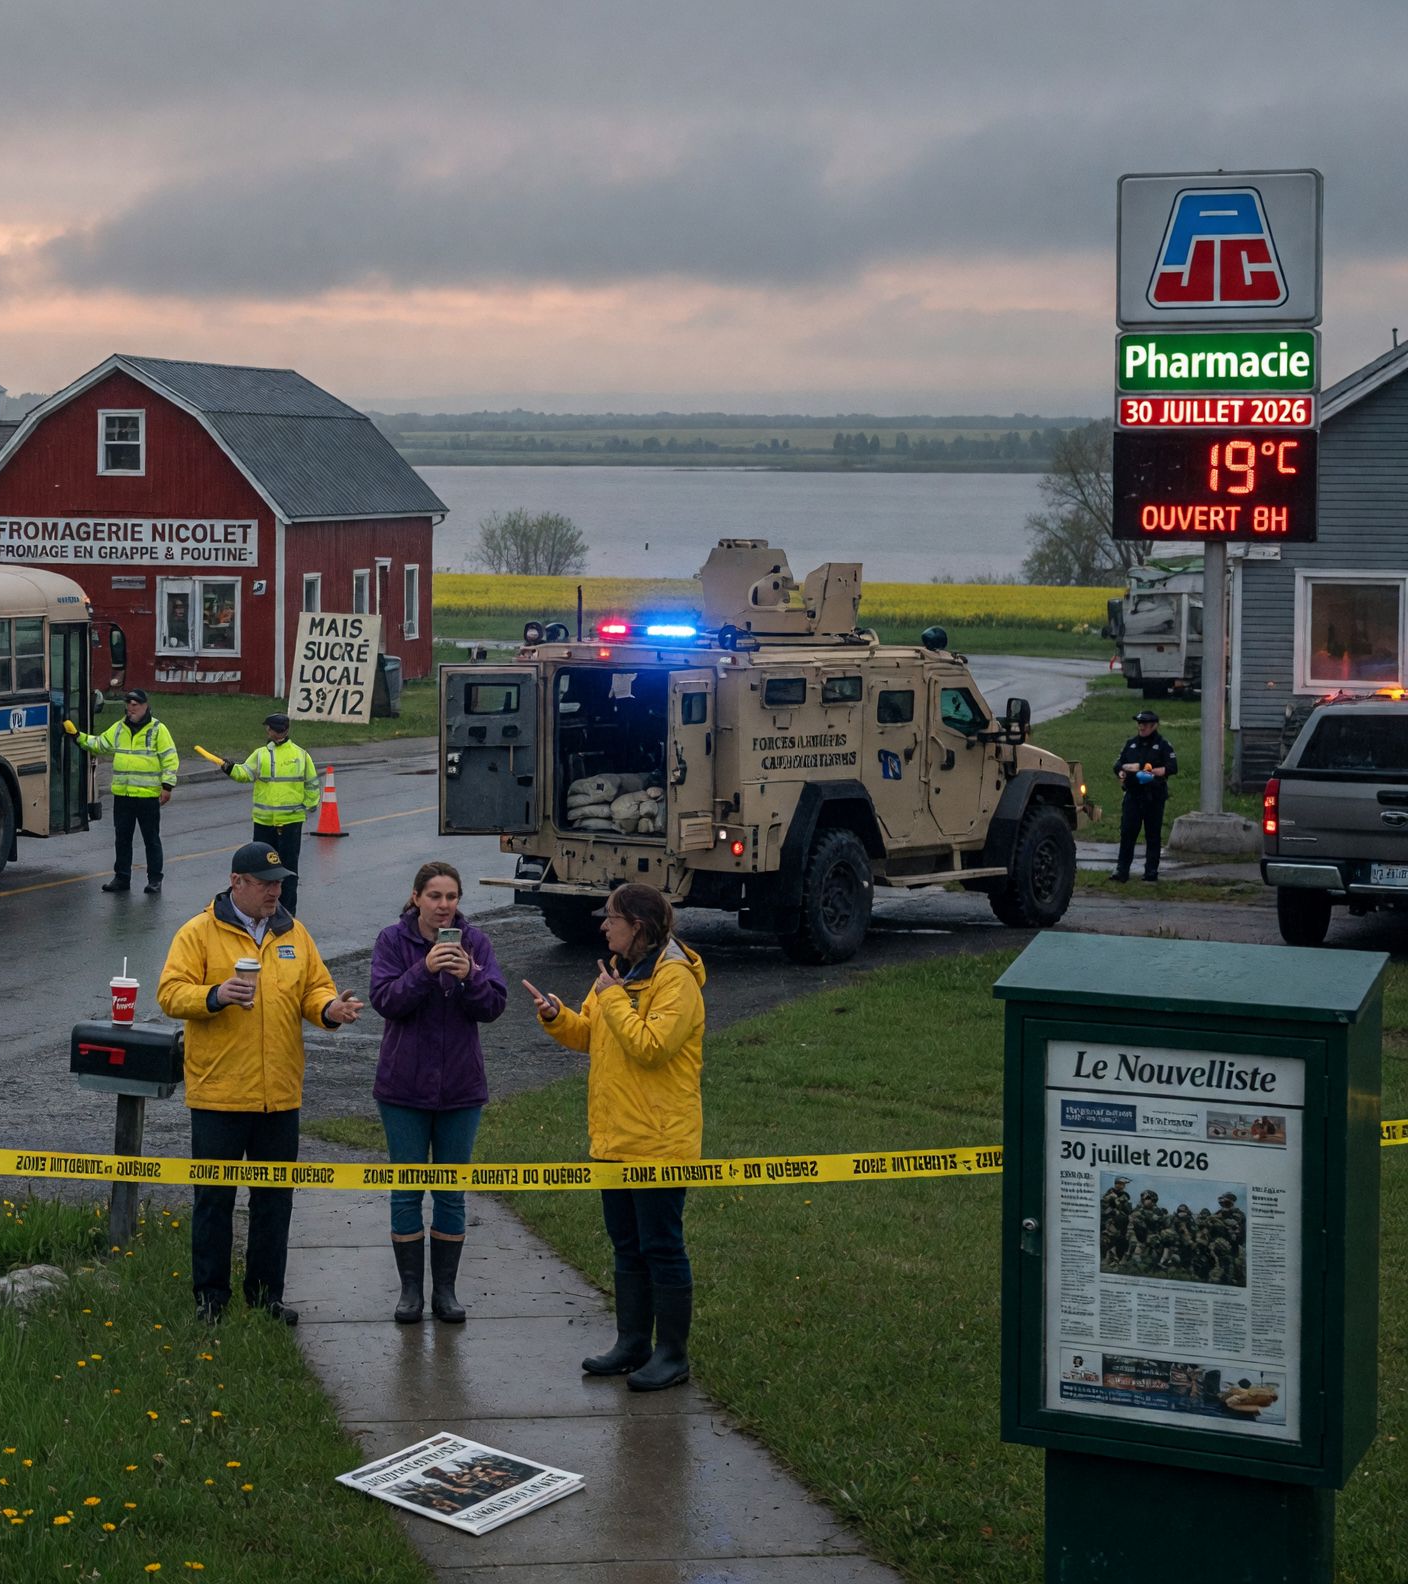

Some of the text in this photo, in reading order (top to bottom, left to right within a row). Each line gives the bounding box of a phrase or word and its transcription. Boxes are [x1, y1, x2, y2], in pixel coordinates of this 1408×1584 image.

[1125, 341, 1310, 379] Pharmacie
[1126, 400, 1306, 423] 30 JUILLET 2026
[1209, 440, 1298, 495] 19°C
[1141, 505, 1288, 533] OUVERT 8H
[151, 523, 252, 544] NICOLET
[74, 545, 93, 558] EN
[98, 546, 158, 560] GRAPPE
[309, 617, 363, 639] MAIS
[303, 639, 370, 662] SUCRÉ
[299, 664, 364, 686] LOCAL
[1073, 1051, 1277, 1093] Le Nouvelliste
[1060, 1140, 1209, 1171] 30 juillet 2026
